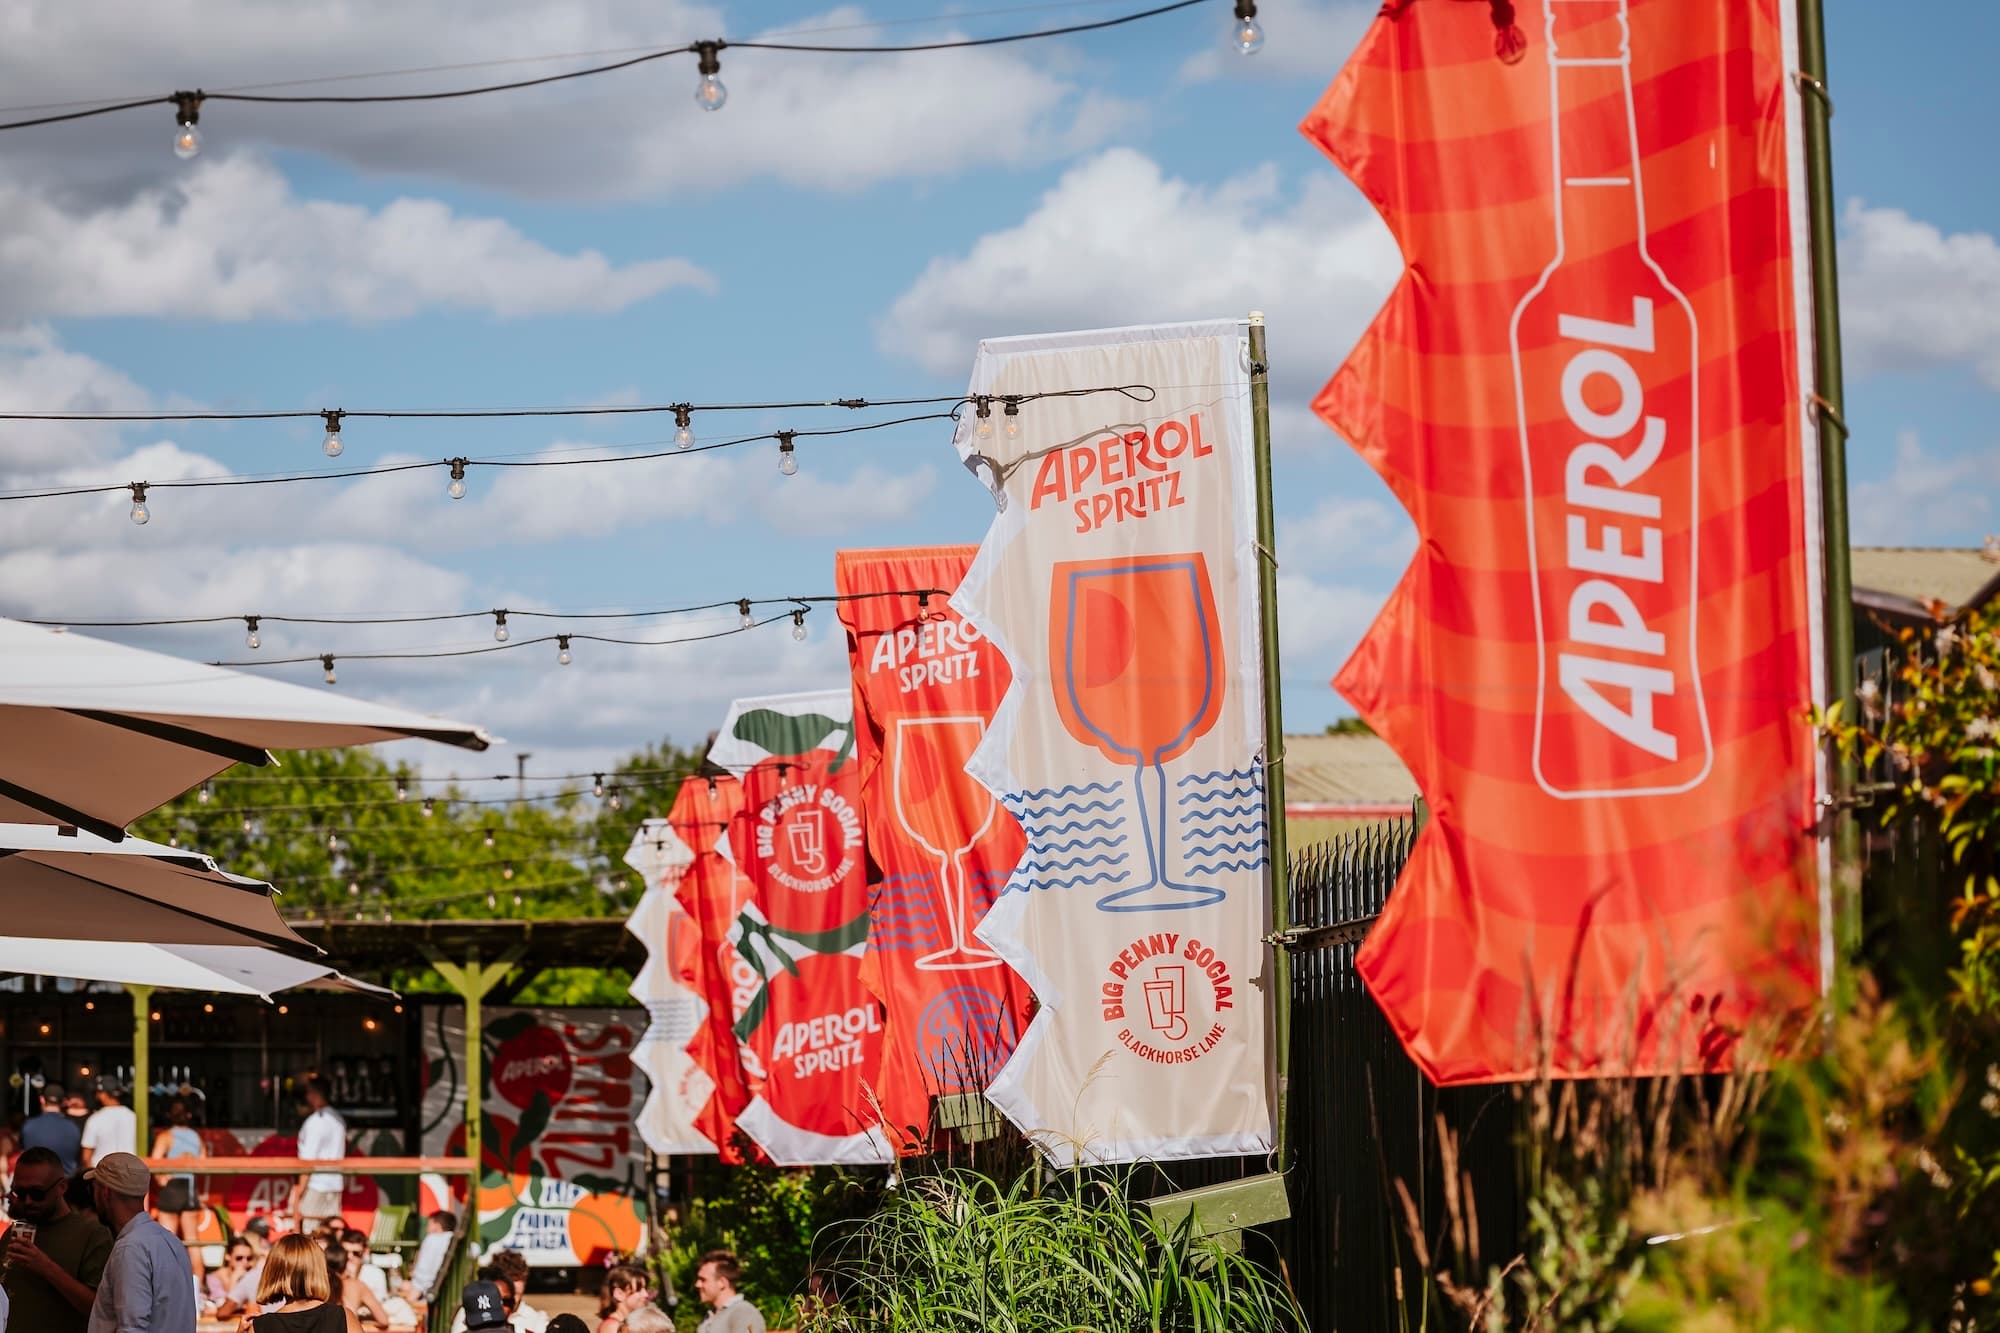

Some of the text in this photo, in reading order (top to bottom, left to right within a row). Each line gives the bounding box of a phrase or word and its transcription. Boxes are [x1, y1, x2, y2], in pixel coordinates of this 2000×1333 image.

[1031, 413, 1213, 511] APEROL
[1076, 470, 1185, 534] SPRITZ
[1557, 296, 1678, 762] APEROL
[870, 618, 992, 674] APERO
[900, 651, 980, 694] SPRITZ
[756, 825, 775, 859] BIG
[820, 788, 863, 850] SOCIAL
[1101, 933, 1233, 1022] BIG PENNY SOCIAL
[772, 1007, 881, 1062] APEROL
[794, 1039, 865, 1079] SPRITZ
[1117, 1022, 1227, 1065] BLACKHORSE LANE
[502, 1055, 567, 1084] APEROL
[540, 1024, 633, 1181] SPRITZ
